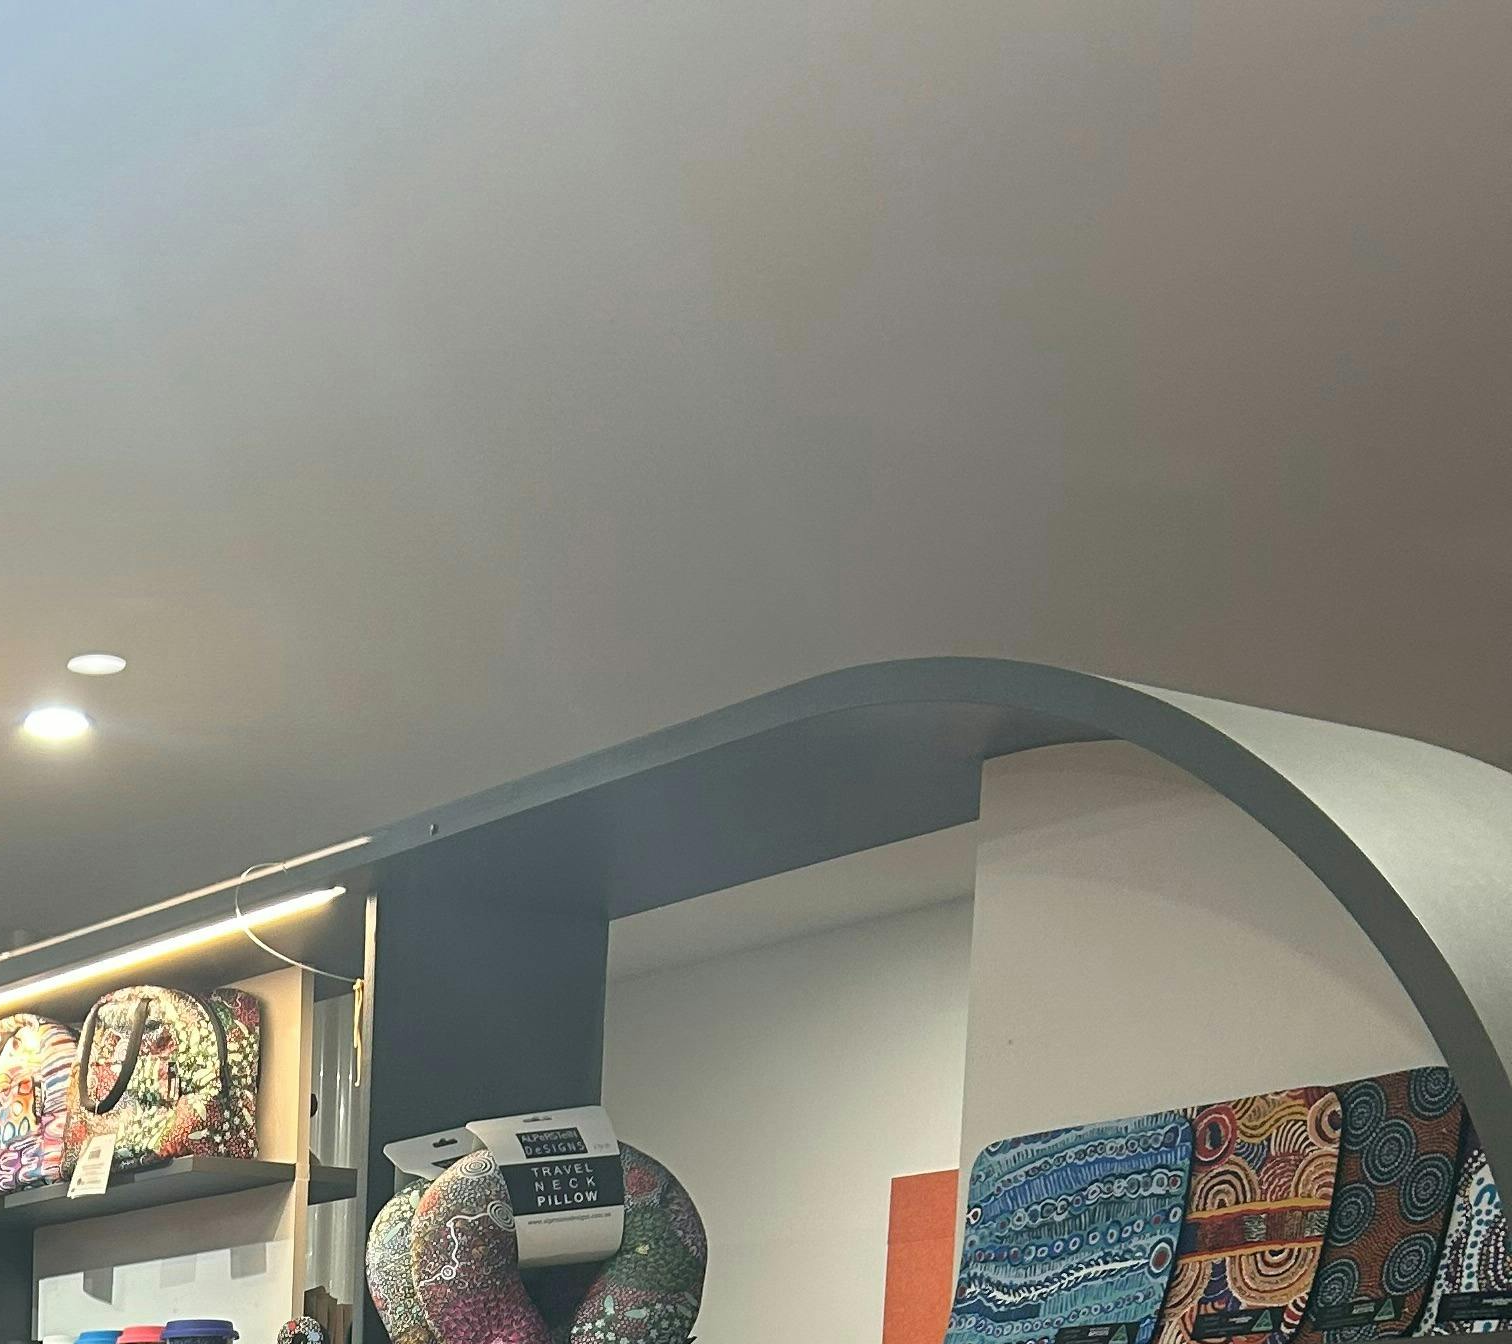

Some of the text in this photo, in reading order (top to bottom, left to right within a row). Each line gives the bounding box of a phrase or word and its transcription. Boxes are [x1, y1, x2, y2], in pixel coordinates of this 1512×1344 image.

[531, 1162, 594, 1178] TRAVEL
[534, 1175, 596, 1192] NECK
[537, 1190, 598, 1207] PILLOW
